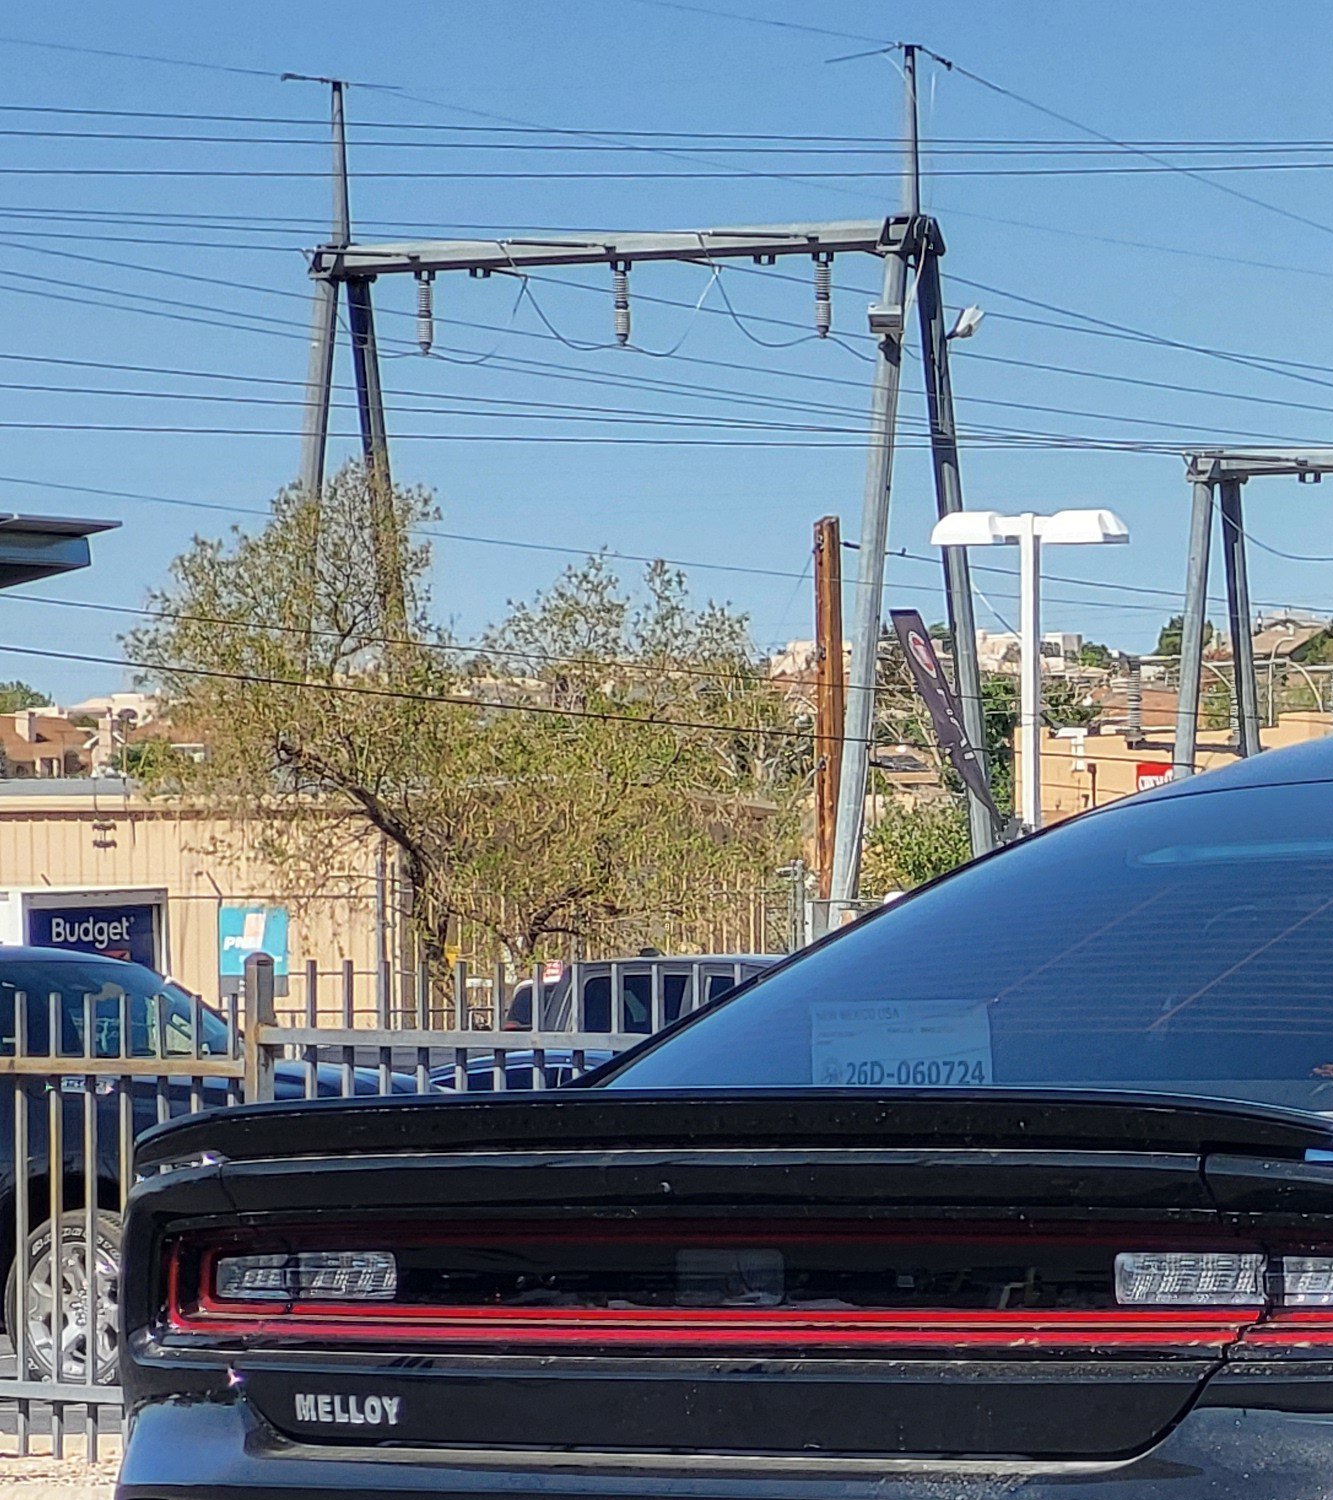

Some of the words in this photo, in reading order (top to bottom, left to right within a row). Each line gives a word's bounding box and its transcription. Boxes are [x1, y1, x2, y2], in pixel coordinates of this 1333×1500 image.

[51, 917, 131, 949] Budget
[846, 1060, 986, 1086] 26D-060724
[295, 1393, 400, 1425] MELLOY
